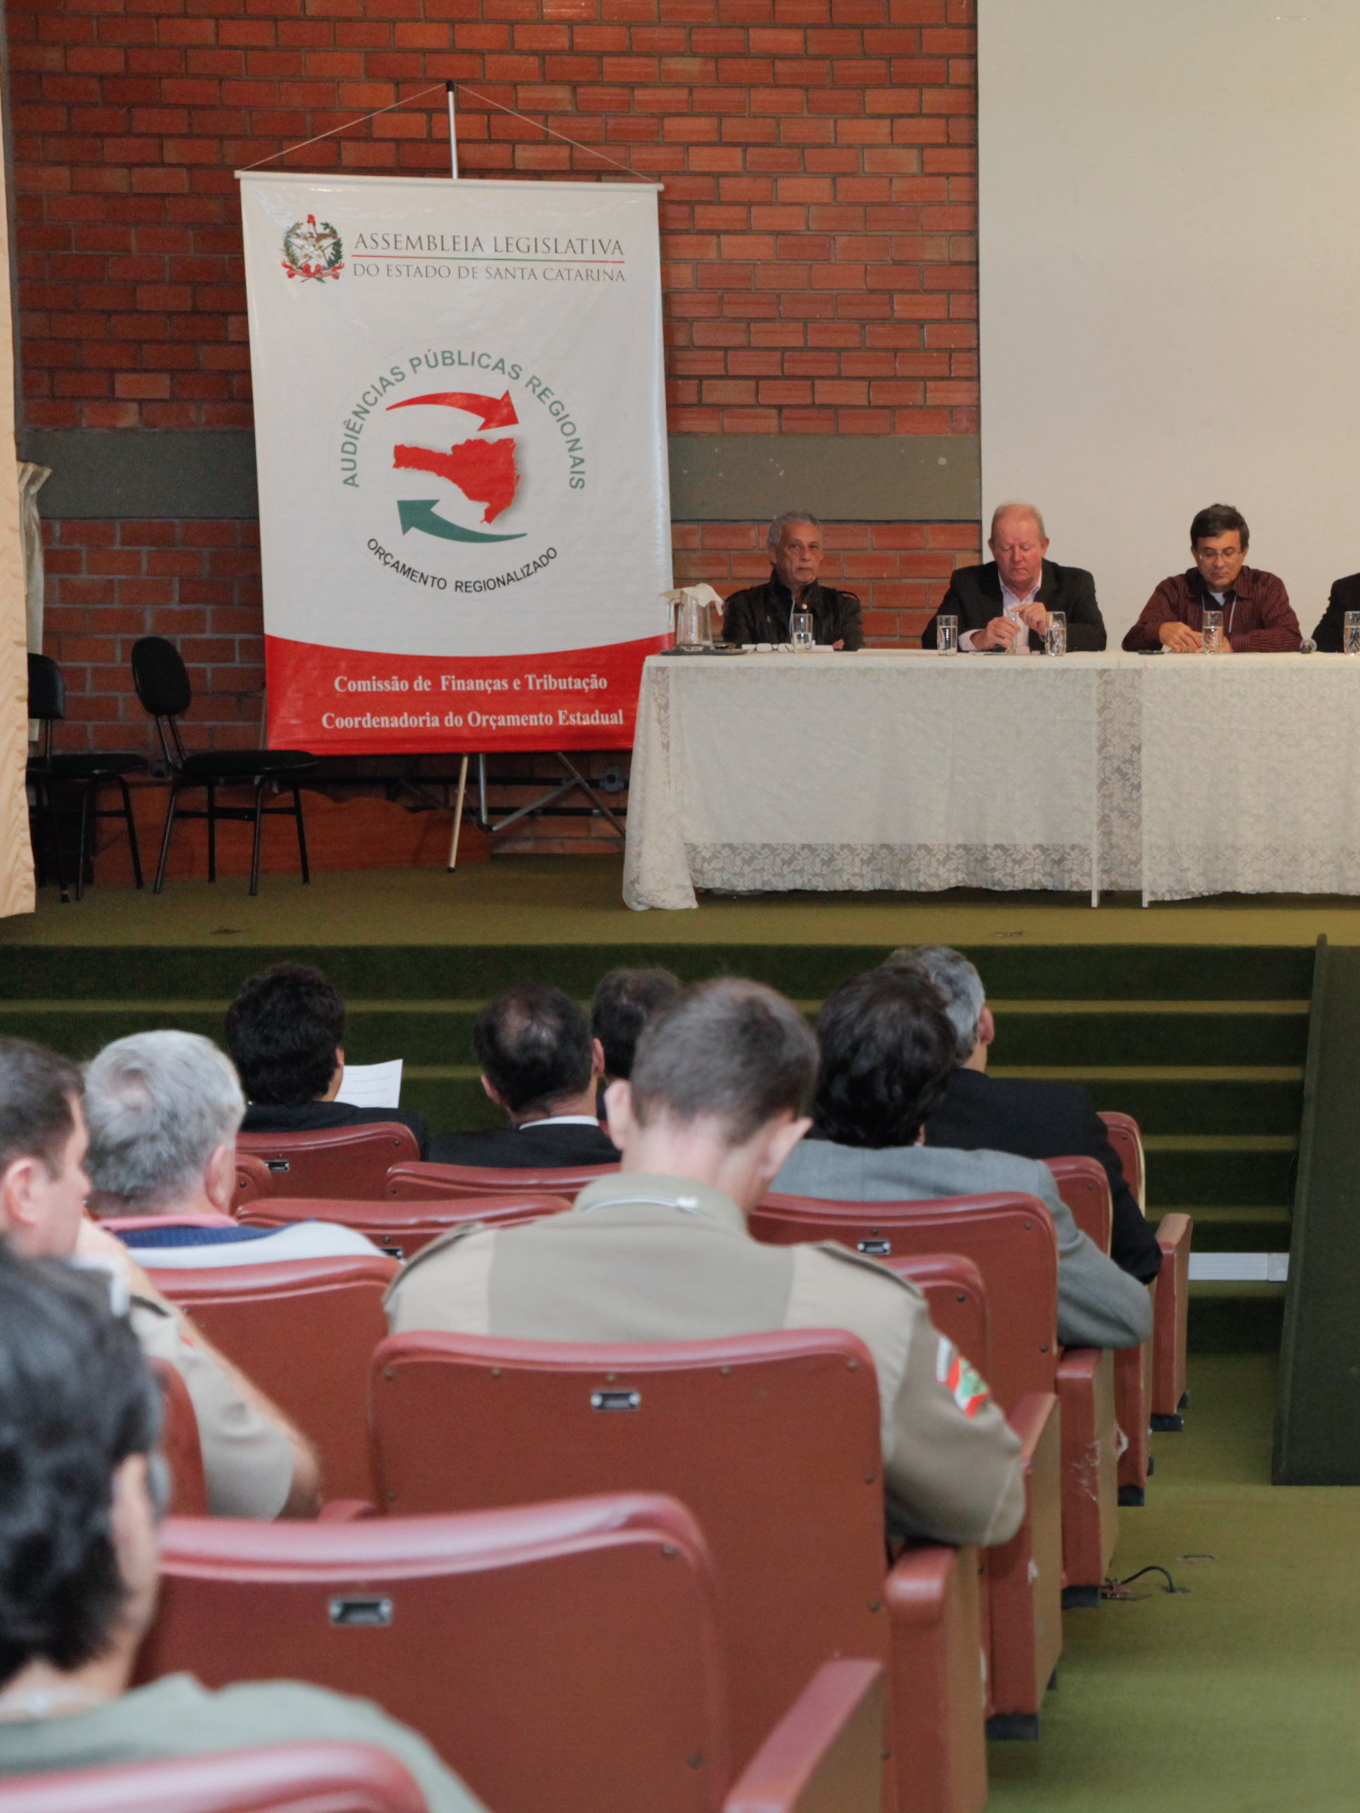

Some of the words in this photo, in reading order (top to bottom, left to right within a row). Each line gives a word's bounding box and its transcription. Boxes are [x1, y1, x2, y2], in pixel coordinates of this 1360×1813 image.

[354, 232, 484, 254] ASSEMBLEIA
[493, 237, 625, 256] LEGISLATIVA
[353, 263, 380, 277] DO
[386, 264, 451, 279] ESTADO
[458, 266, 479, 280] DE
[485, 267, 538, 282] SANTA
[543, 268, 626, 283] CATARINA
[341, 366, 406, 489] AUDIÊNCIAS
[409, 348, 522, 381] PÚBLICAS
[525, 375, 586, 490] REGIONAIS
[366, 538, 448, 590] ORÇAMENTO
[454, 546, 558, 593] REGIONALIZADO
[334, 675, 409, 693] Comissão
[413, 675, 432, 692] de
[440, 675, 509, 693] Finanças
[512, 679, 521, 691] e
[524, 674, 608, 690] Tributação
[321, 712, 440, 729] Coordenadoria
[444, 712, 464, 728] do
[467, 711, 553, 730] Orçamento
[557, 709, 624, 726] Estadual
